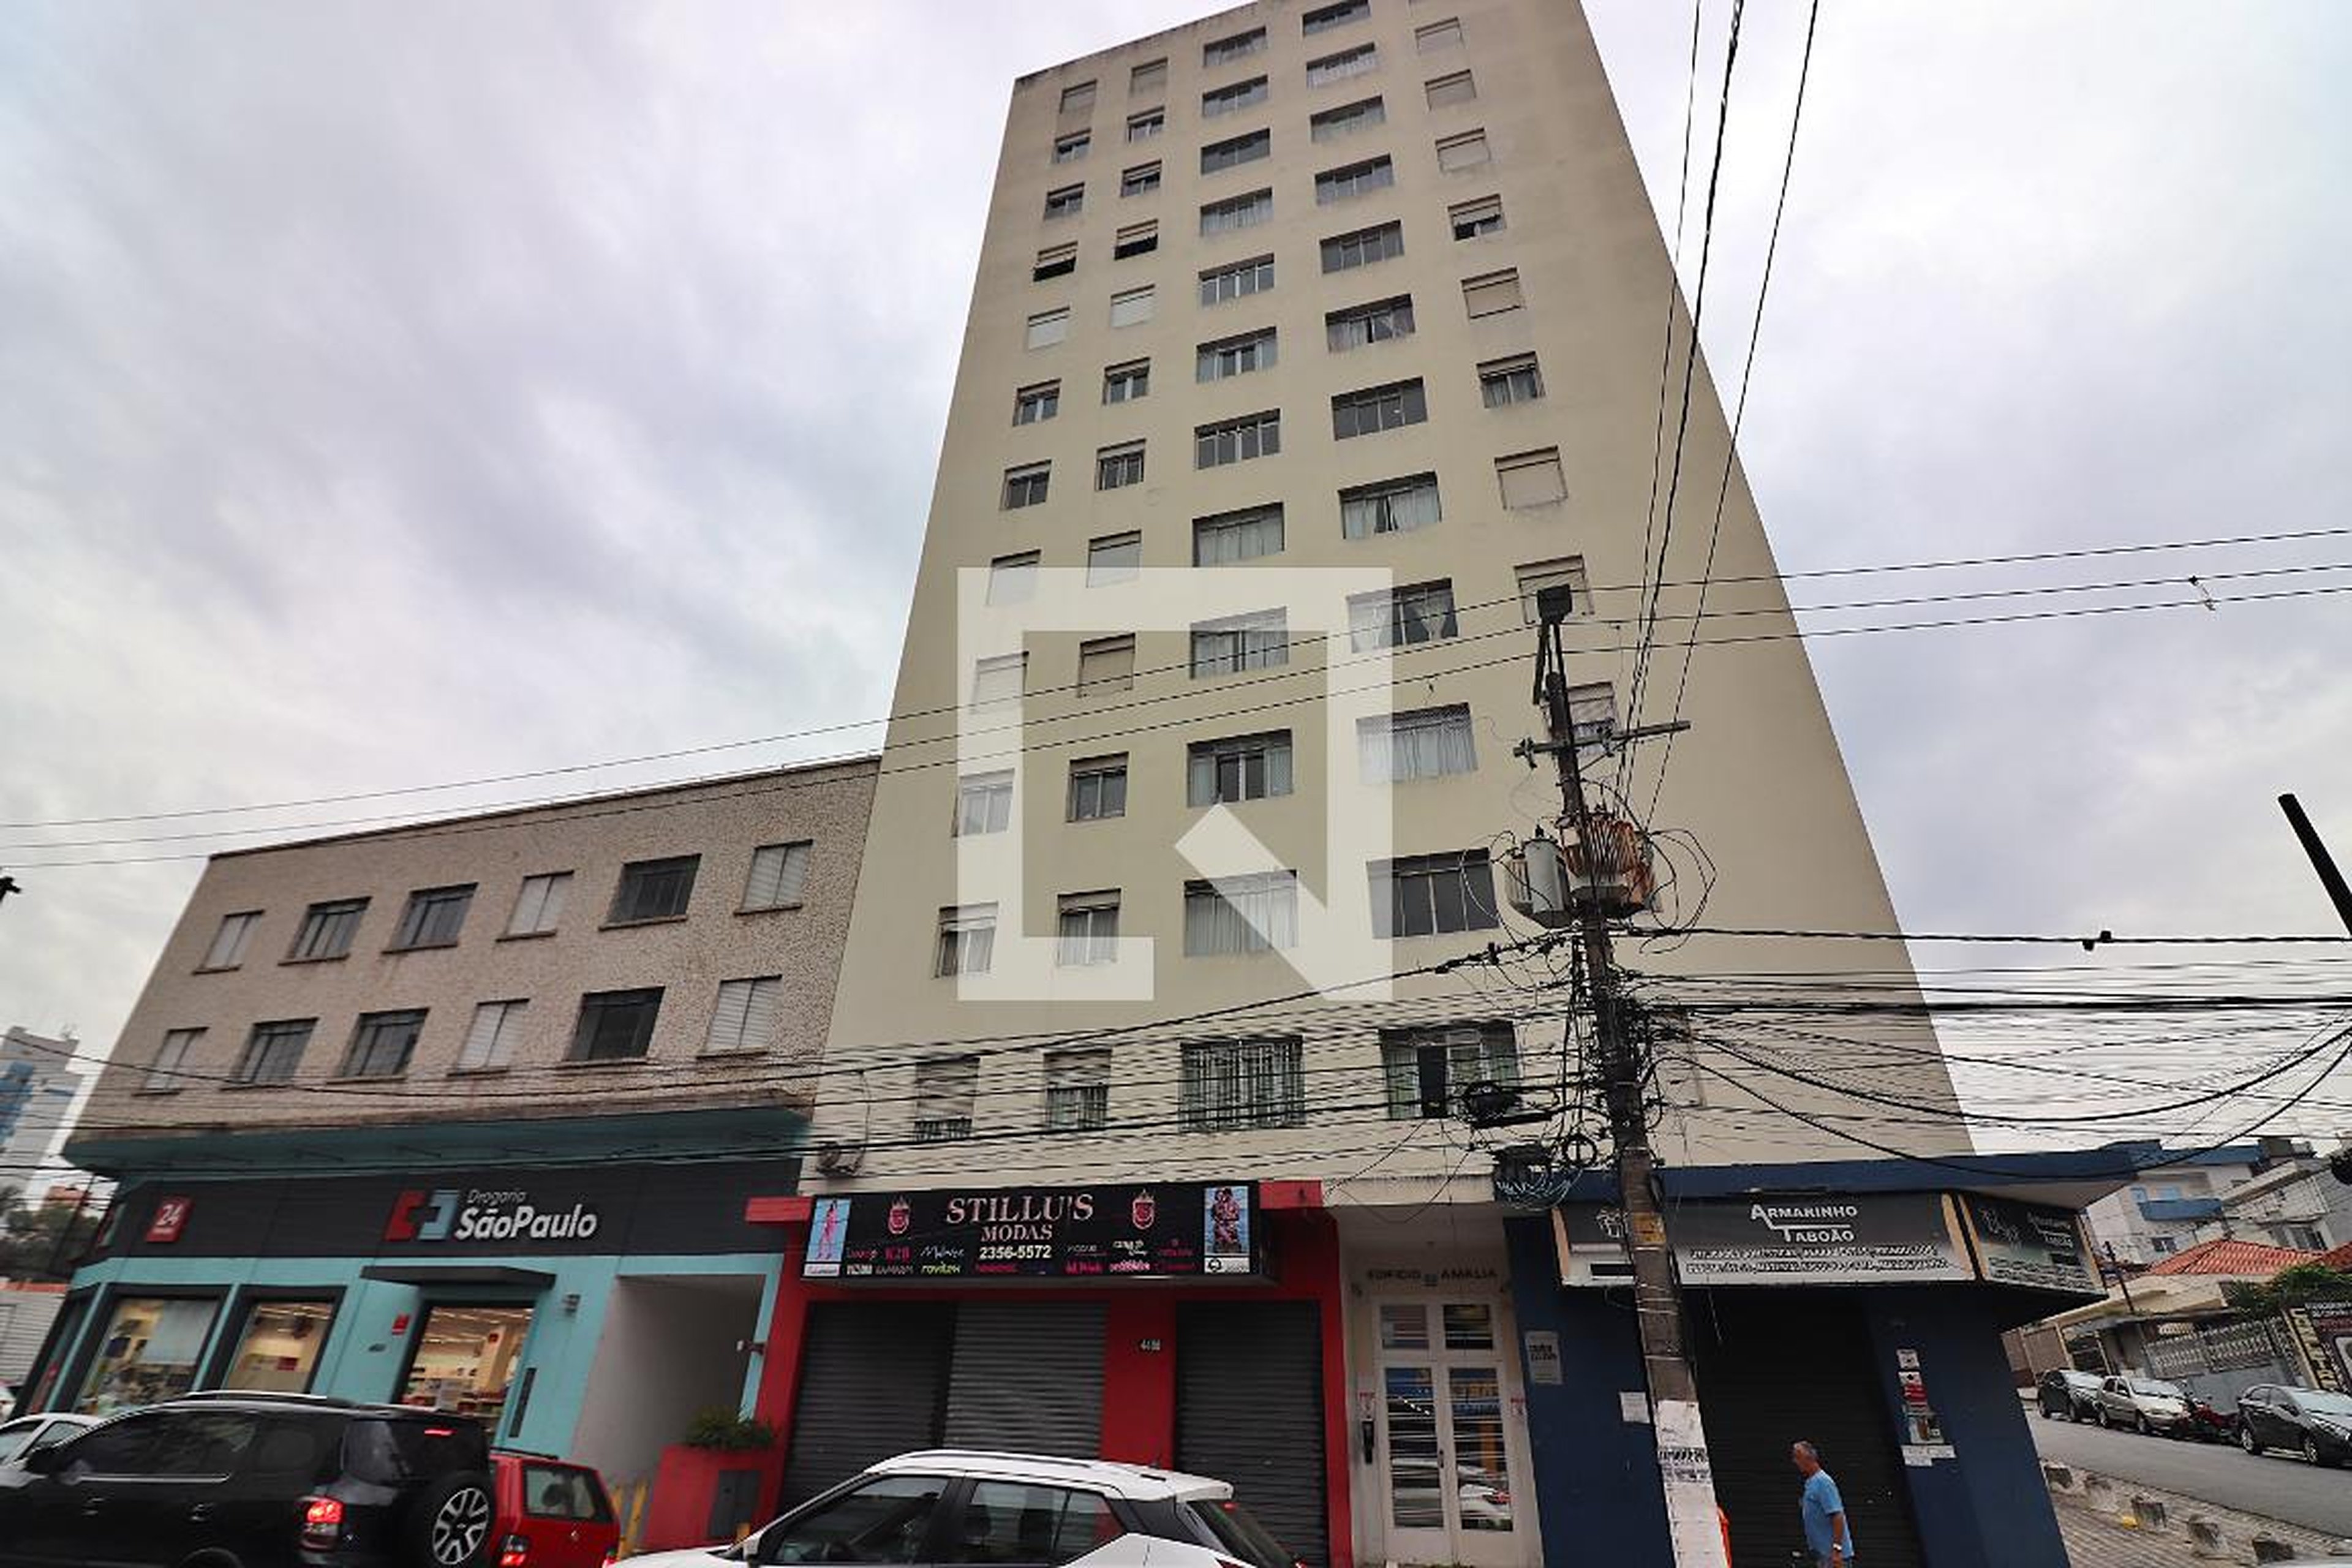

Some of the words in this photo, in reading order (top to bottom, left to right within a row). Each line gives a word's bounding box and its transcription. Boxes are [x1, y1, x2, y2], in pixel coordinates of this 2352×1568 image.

[467, 1189, 527, 1205] Drogaria
[156, 1204, 183, 1226] 24
[946, 1193, 1095, 1224] STILLU'S
[454, 1204, 597, 1240] SãoPaulo
[981, 1224, 1053, 1242] MODAS
[979, 1244, 1052, 1259] 2356-5572
